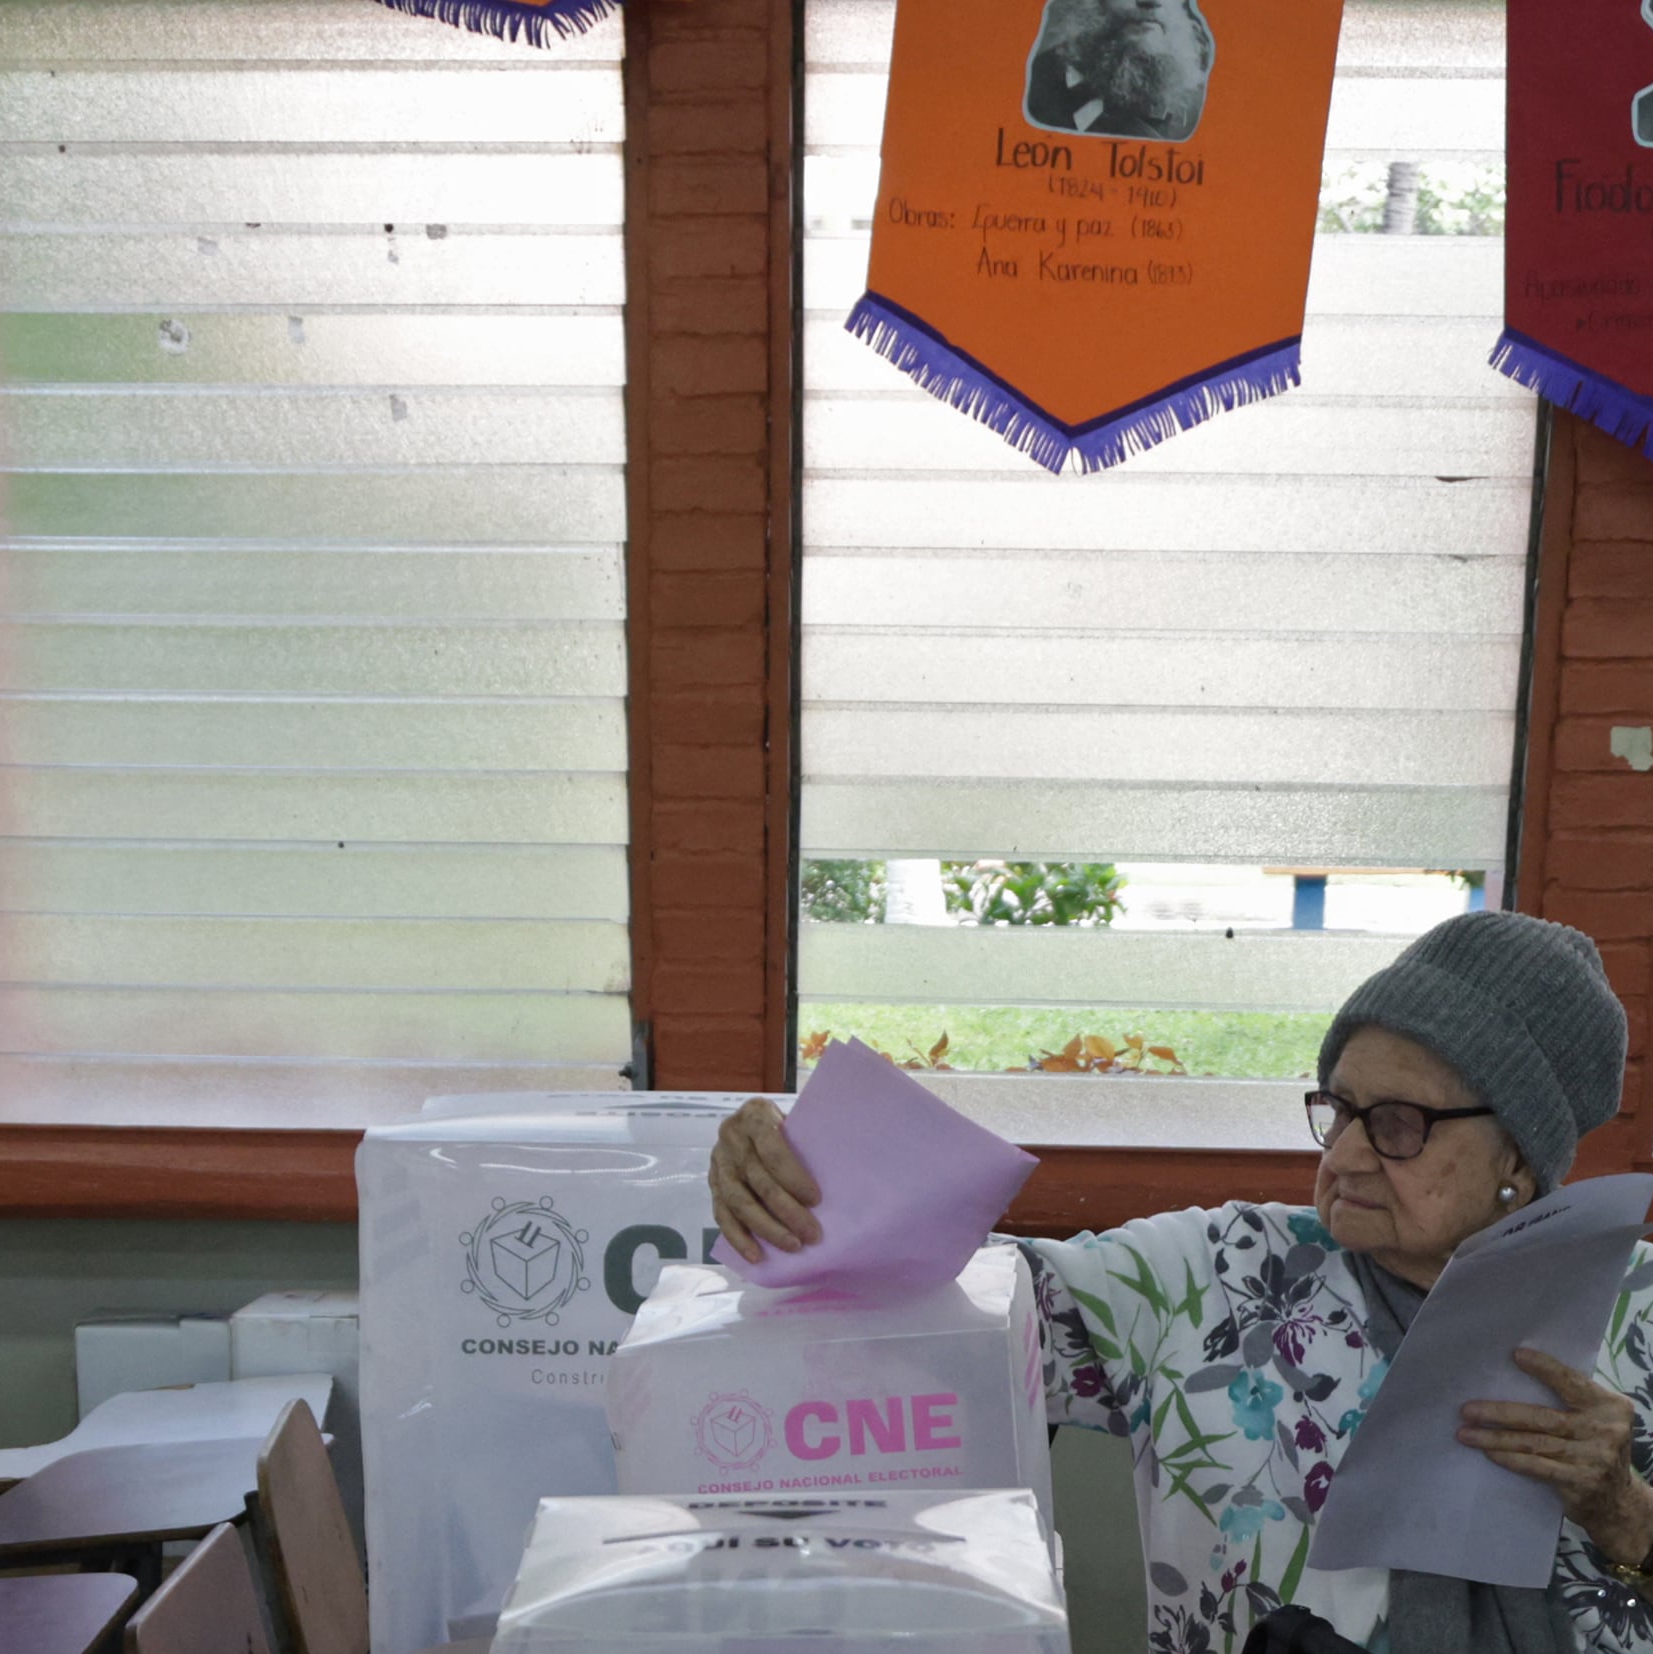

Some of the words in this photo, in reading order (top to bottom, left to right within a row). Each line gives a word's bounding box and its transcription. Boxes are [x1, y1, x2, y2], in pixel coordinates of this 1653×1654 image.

[1101, 141, 1205, 186] Tolstoi
[1056, 218, 1066, 248] y
[1077, 219, 1114, 242] paz
[977, 246, 1018, 278] Ana
[1039, 250, 1138, 285] Karenina
[461, 1339, 579, 1356] CONSEJO
[588, 1340, 619, 1356] NA
[532, 1369, 604, 1385] Constr
[784, 1393, 962, 1461] CNE
[698, 1480, 774, 1494] CONSEJO
[779, 1473, 862, 1489] NACIONAL
[868, 1465, 964, 1483] ELECTORAL
